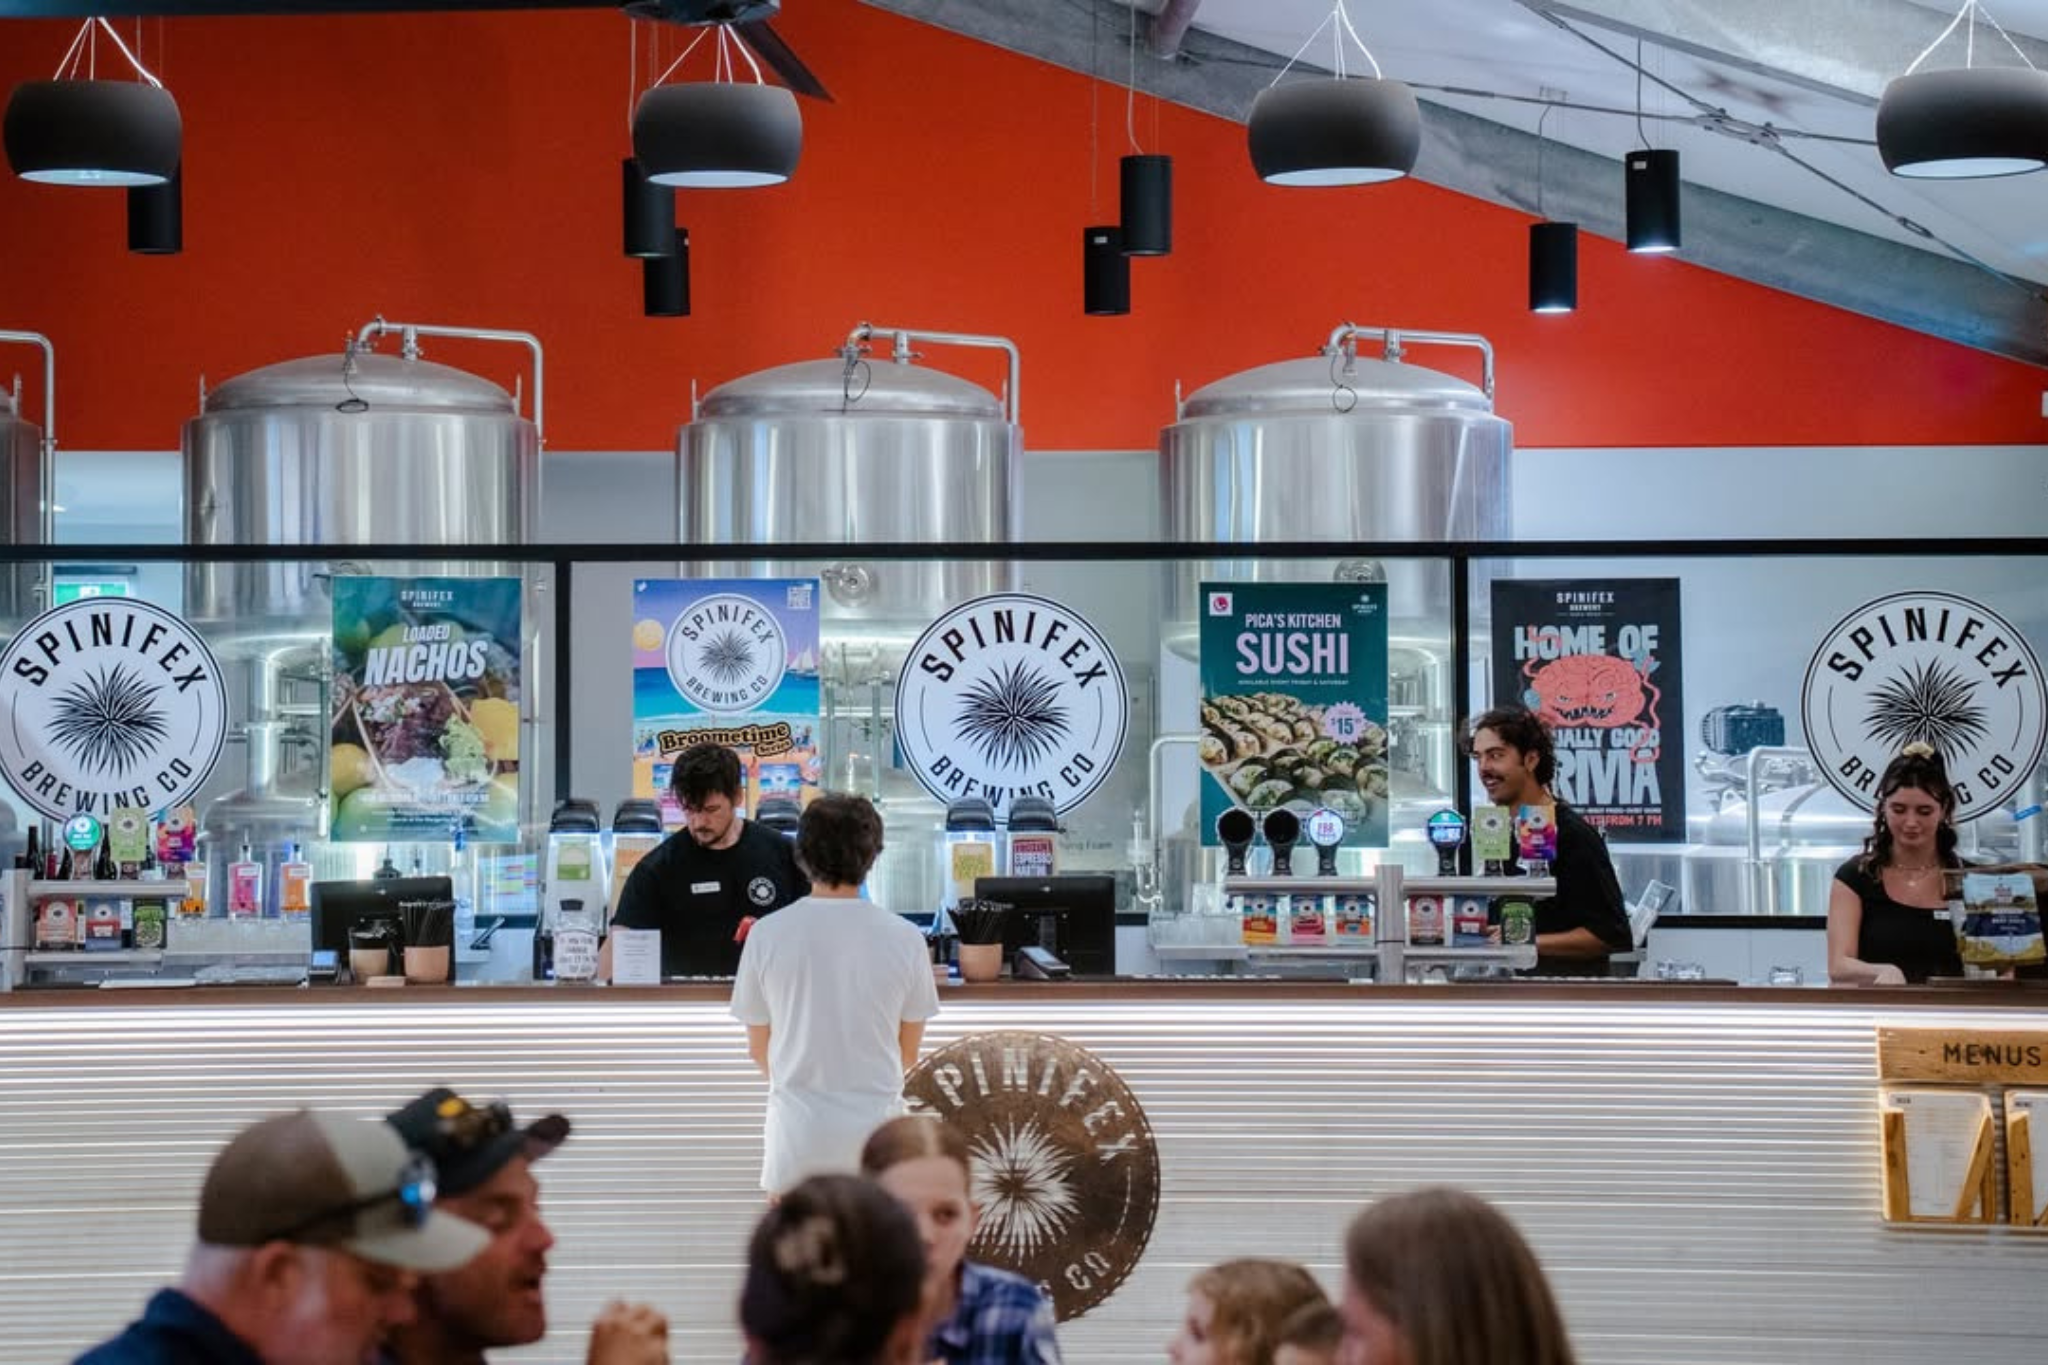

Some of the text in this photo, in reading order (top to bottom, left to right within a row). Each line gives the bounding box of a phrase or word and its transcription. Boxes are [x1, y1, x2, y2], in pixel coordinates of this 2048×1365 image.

[401, 591, 454, 601] SPINIFEX
[1557, 592, 1615, 603] SPINIFEX
[402, 625, 451, 643] LOADED
[681, 604, 775, 644] SPINIFEX
[1245, 613, 1341, 628] PICA'S KITCHEN
[13, 612, 208, 694] SPINIFEX
[920, 609, 1108, 690] SPINIFEX
[1236, 632, 1349, 675] SUSHI
[1514, 625, 1659, 660] HOME OF
[1827, 607, 2028, 689] SPINIFEX
[364, 640, 489, 686] NACHOS
[686, 674, 768, 704] BREWING CO
[661, 723, 788, 750] Broometime
[759, 740, 791, 753] Series
[1610, 728, 1660, 748] GOOD
[21, 757, 193, 815] BREWING CO
[1060, 752, 1095, 787] CO
[1553, 748, 1662, 805] RIVIA
[1977, 754, 2015, 790] CO
[1943, 1042, 2042, 1067] MENUS
[1064, 1251, 1111, 1290] CO
